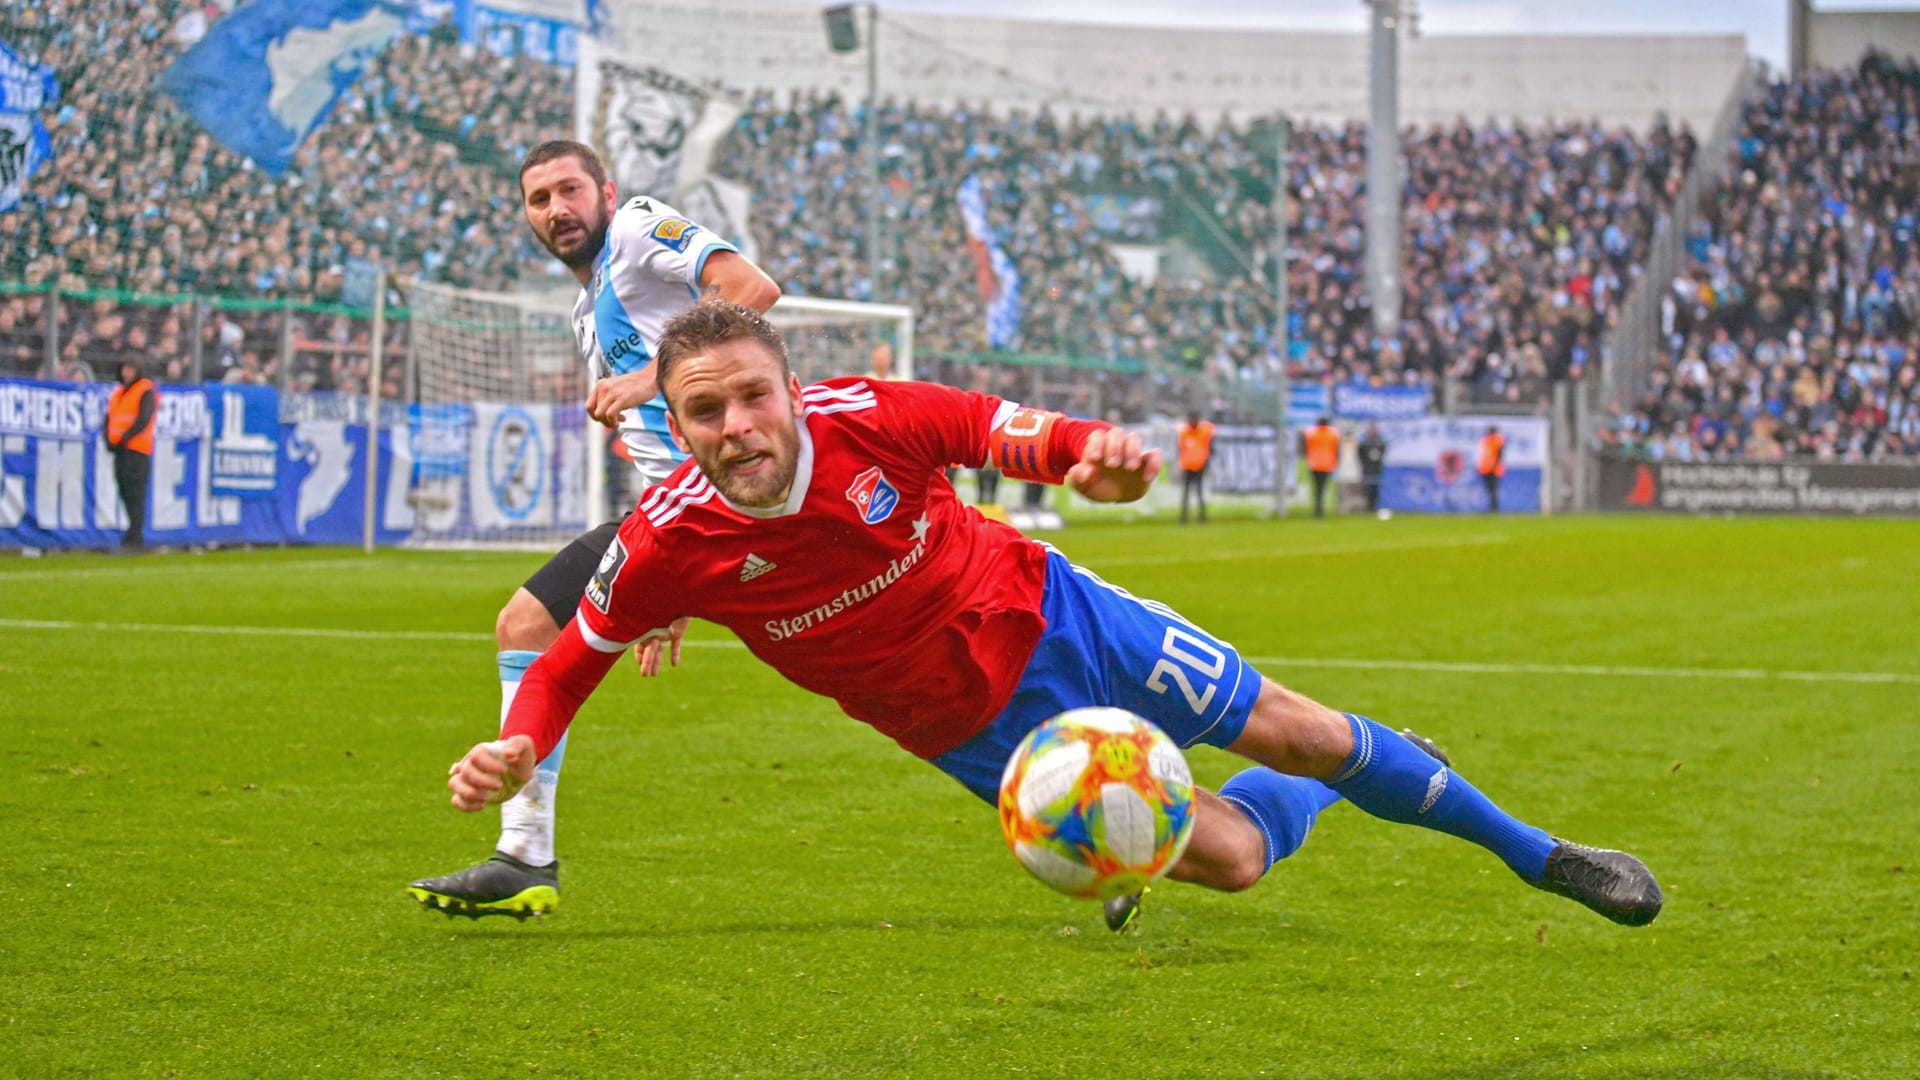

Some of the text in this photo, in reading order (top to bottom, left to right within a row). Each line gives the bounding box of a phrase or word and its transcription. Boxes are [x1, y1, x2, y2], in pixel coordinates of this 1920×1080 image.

[1004, 411, 1046, 437] C
[739, 562, 777, 583] adidas
[764, 542, 926, 642] Sternstunden
[1145, 626, 1227, 716] 20
